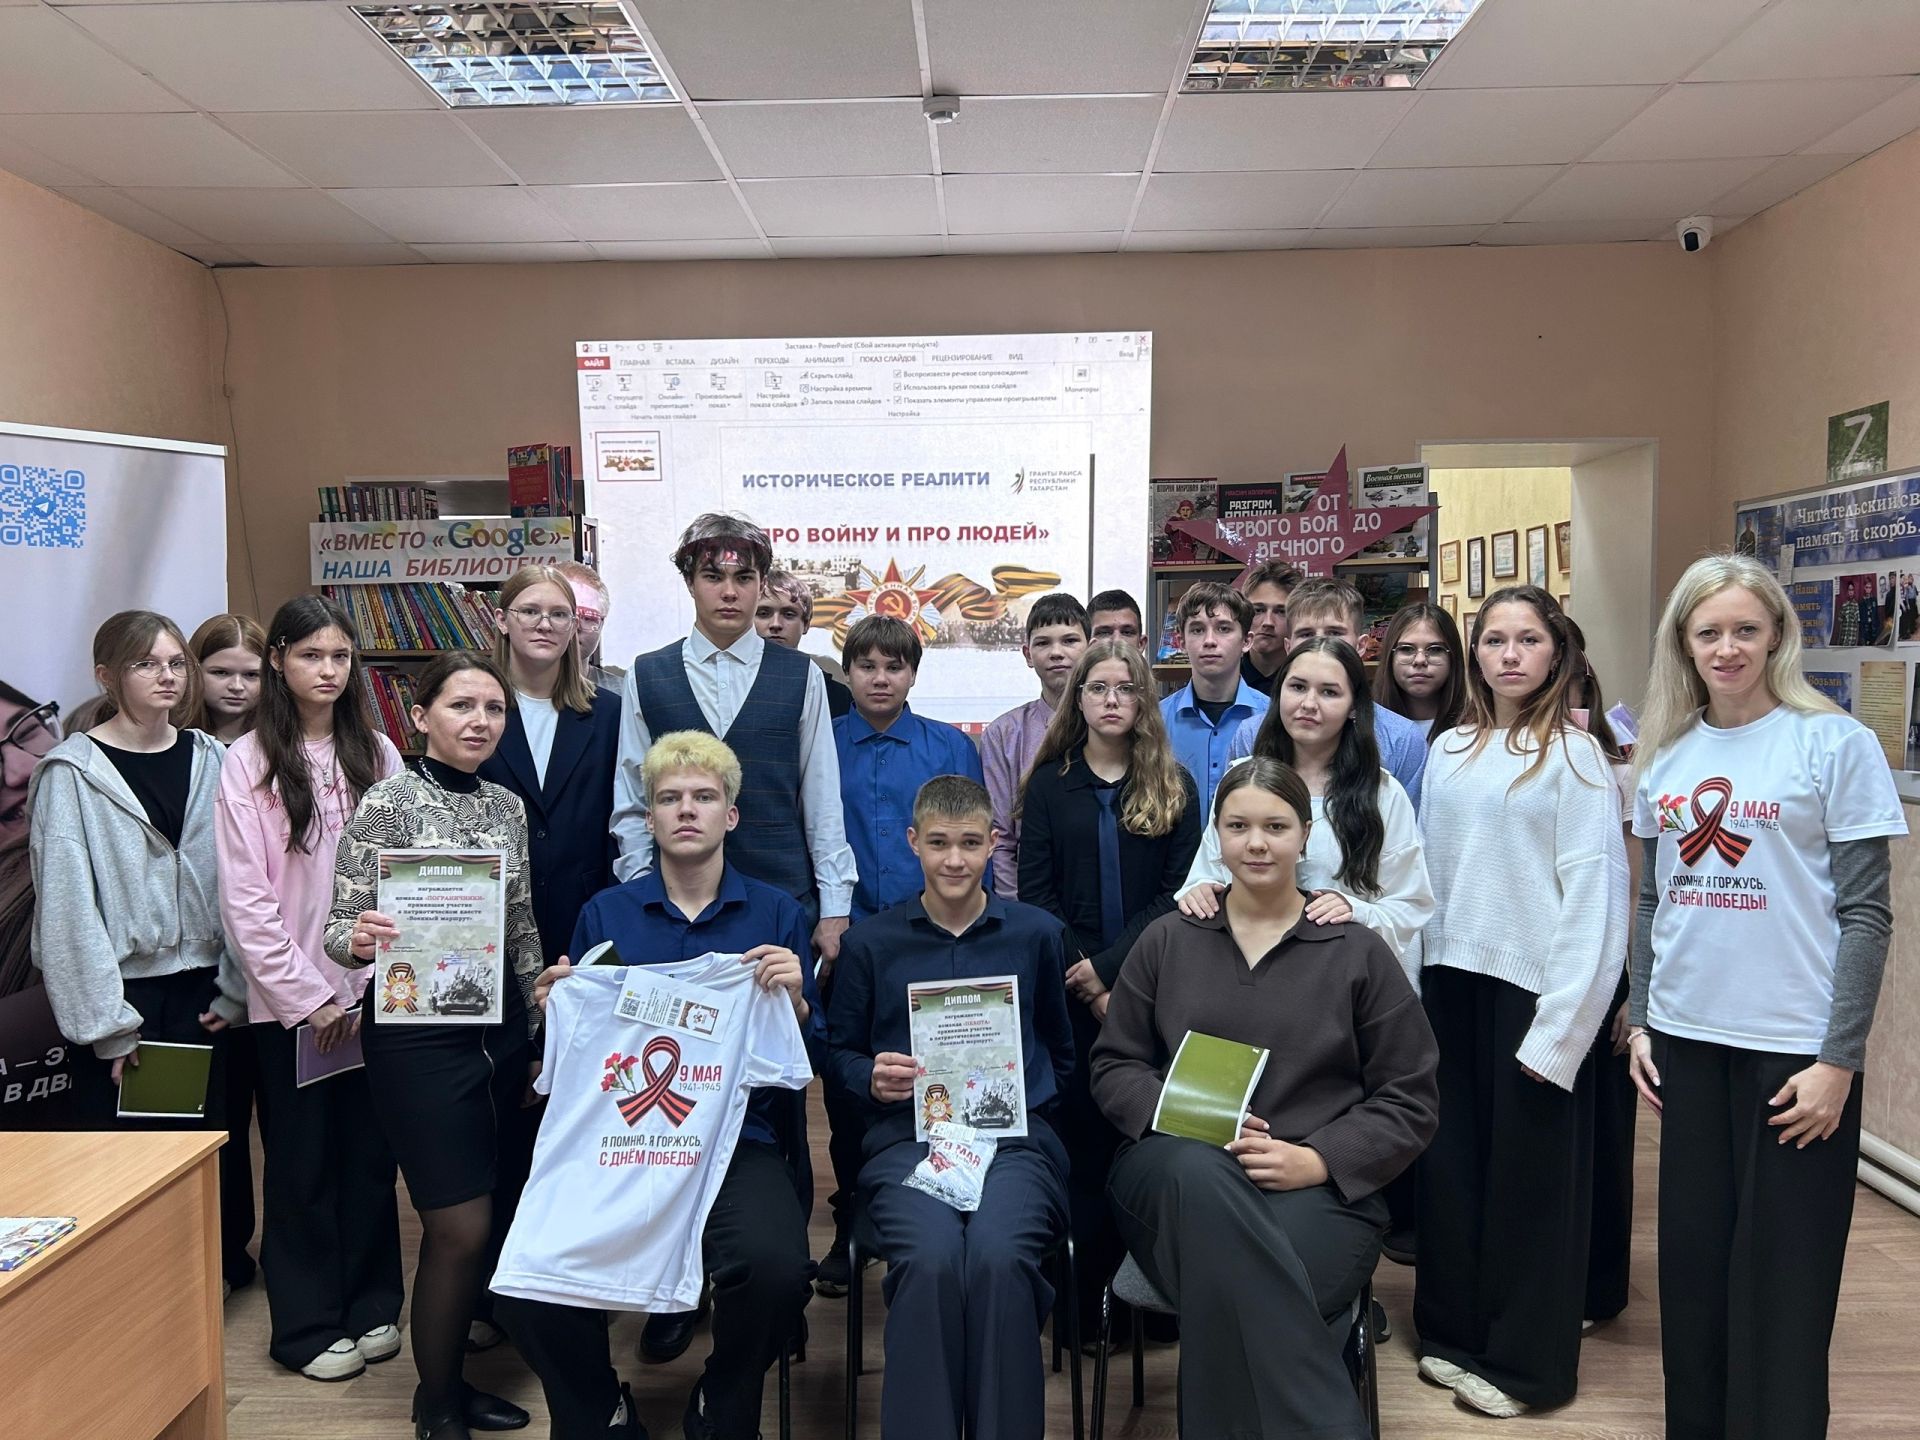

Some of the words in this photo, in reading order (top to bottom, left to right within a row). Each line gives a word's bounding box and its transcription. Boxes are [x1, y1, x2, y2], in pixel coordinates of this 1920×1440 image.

[785, 342, 813, 350] Заставка
[818, 342, 853, 350] PowerPoint
[854, 341, 873, 349] (Сбой
[584, 359, 604, 367] ФАЙЛ
[619, 358, 651, 366] ГЛАВНАЯ
[665, 358, 696, 366] ВСТАВКА
[710, 356, 740, 366] ДИЗАЙН
[754, 356, 790, 365] ПЕРЕХОДЫ
[804, 356, 845, 364] АНИМАЦИЯ
[859, 355, 883, 363] ПОКАЗ
[883, 354, 916, 363] СЛАЙДОВ
[931, 353, 993, 362] РЕЦЕНЗИРОВАНИЕ
[1008, 353, 1024, 361] ВИД
[742, 473, 895, 489] ИСТОРИЧЕСКОЕ
[901, 471, 990, 487] РЕАЛИТИ
[1366, 472, 1392, 483] Военная
[1393, 471, 1421, 481] техника
[1229, 499, 1273, 510] РАЗГРОМ
[1317, 494, 1341, 512] ОТ
[1300, 514, 1338, 534] БОЯ
[1352, 512, 1382, 533] ДО
[807, 524, 879, 543] ВОЙНУ
[886, 527, 900, 542] И
[907, 526, 951, 542] ПРО
[957, 521, 1050, 542] ЛЮДЕЙ»
[320, 531, 426, 551] «ВМЕСТО
[1796, 531, 1845, 549] память
[1850, 529, 1859, 542] и
[1257, 536, 1345, 559] ВЕЧНОГО
[322, 559, 392, 580] НАША
[1795, 583, 1819, 595] Наша
[1729, 801, 1740, 819] 9
[1743, 800, 1781, 821] МАЯ
[1729, 819, 1780, 831] 1941-1945
[418, 865, 463, 877] ДИПЛОМ
[1705, 876, 1712, 888] Я
[1712, 875, 1767, 891] ГОРЖУСЬ.
[1668, 890, 1678, 904] С
[1679, 888, 1703, 907] ДНЁМ
[1705, 892, 1768, 911] ПОБЕДЫ!
[944, 993, 981, 1007] ДИПЛОМ
[679, 1066, 688, 1082] 9
[691, 1065, 722, 1082] МАЯ
[4, 1083, 23, 1104] В
[27, 1073, 73, 1102] ДВ
[679, 1082, 721, 1092] 1941-1945
[601, 1136, 609, 1148] Я
[649, 1135, 655, 1147] Я
[656, 1135, 703, 1148] ГОРЖУСЬ.
[599, 1151, 608, 1166] С
[609, 1148, 646, 1167] ДНЁМ
[647, 1151, 702, 1167] ПОБЕДЫ!
